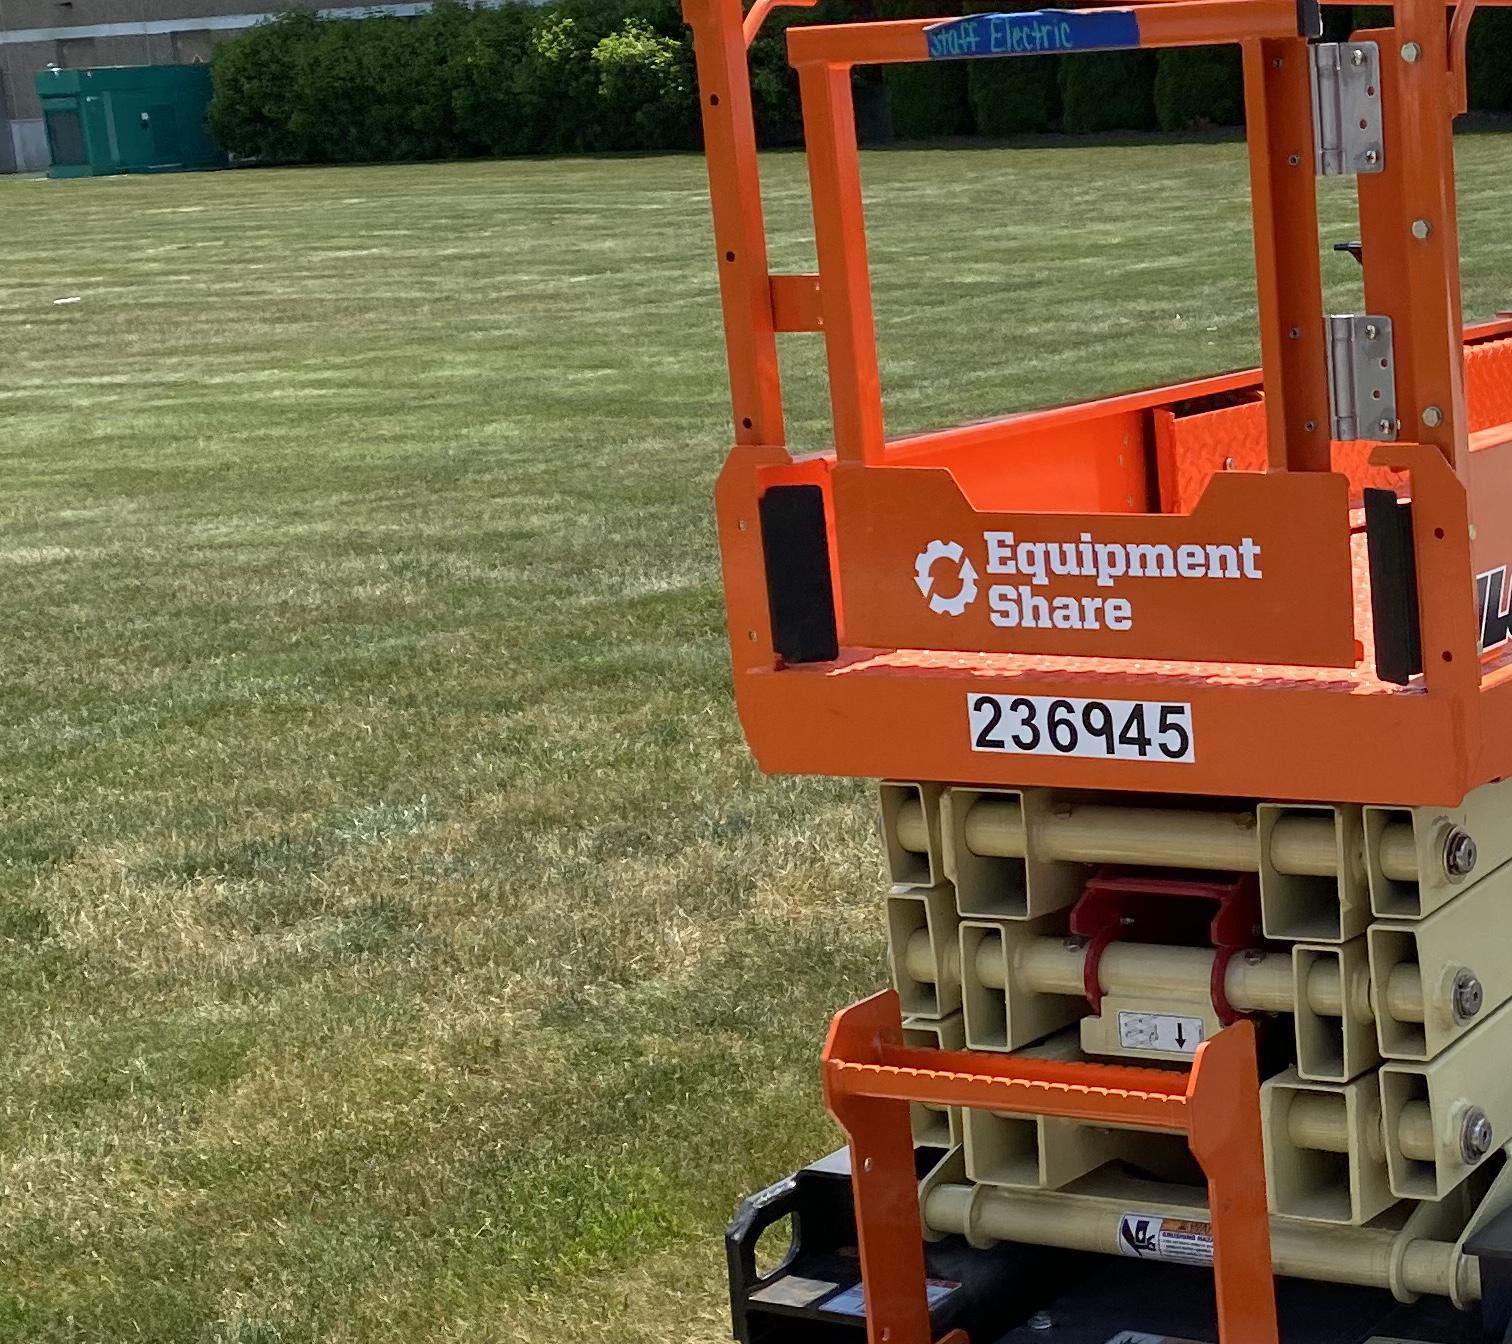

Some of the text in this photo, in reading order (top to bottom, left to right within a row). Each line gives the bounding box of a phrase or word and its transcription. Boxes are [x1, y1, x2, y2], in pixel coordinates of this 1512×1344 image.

[990, 16, 1073, 53] Electric
[983, 531, 1263, 587] Equipment
[988, 584, 1134, 631] Share
[973, 695, 1189, 759] 236945
